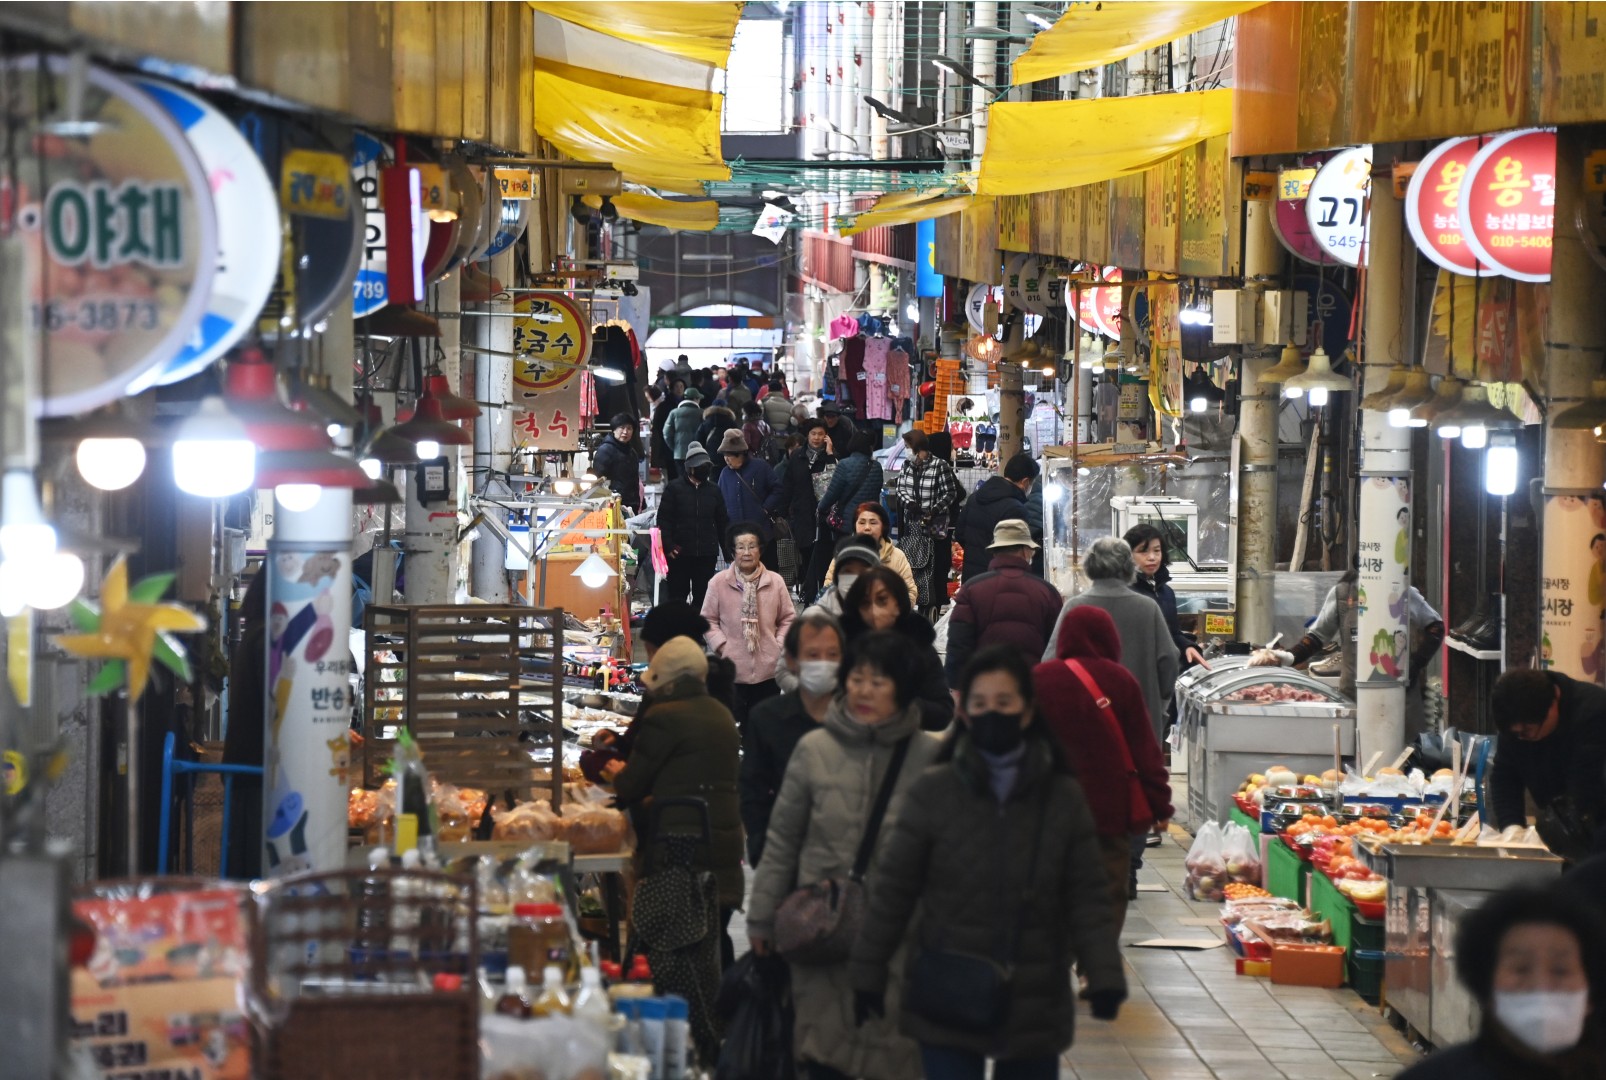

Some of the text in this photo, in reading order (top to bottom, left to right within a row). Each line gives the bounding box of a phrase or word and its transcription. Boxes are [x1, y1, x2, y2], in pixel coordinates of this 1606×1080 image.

[50, 184, 181, 262] 야채
[1317, 196, 1366, 227] 고기
[1359, 558, 1384, 573] 시장
[1540, 598, 1575, 617] 시장
